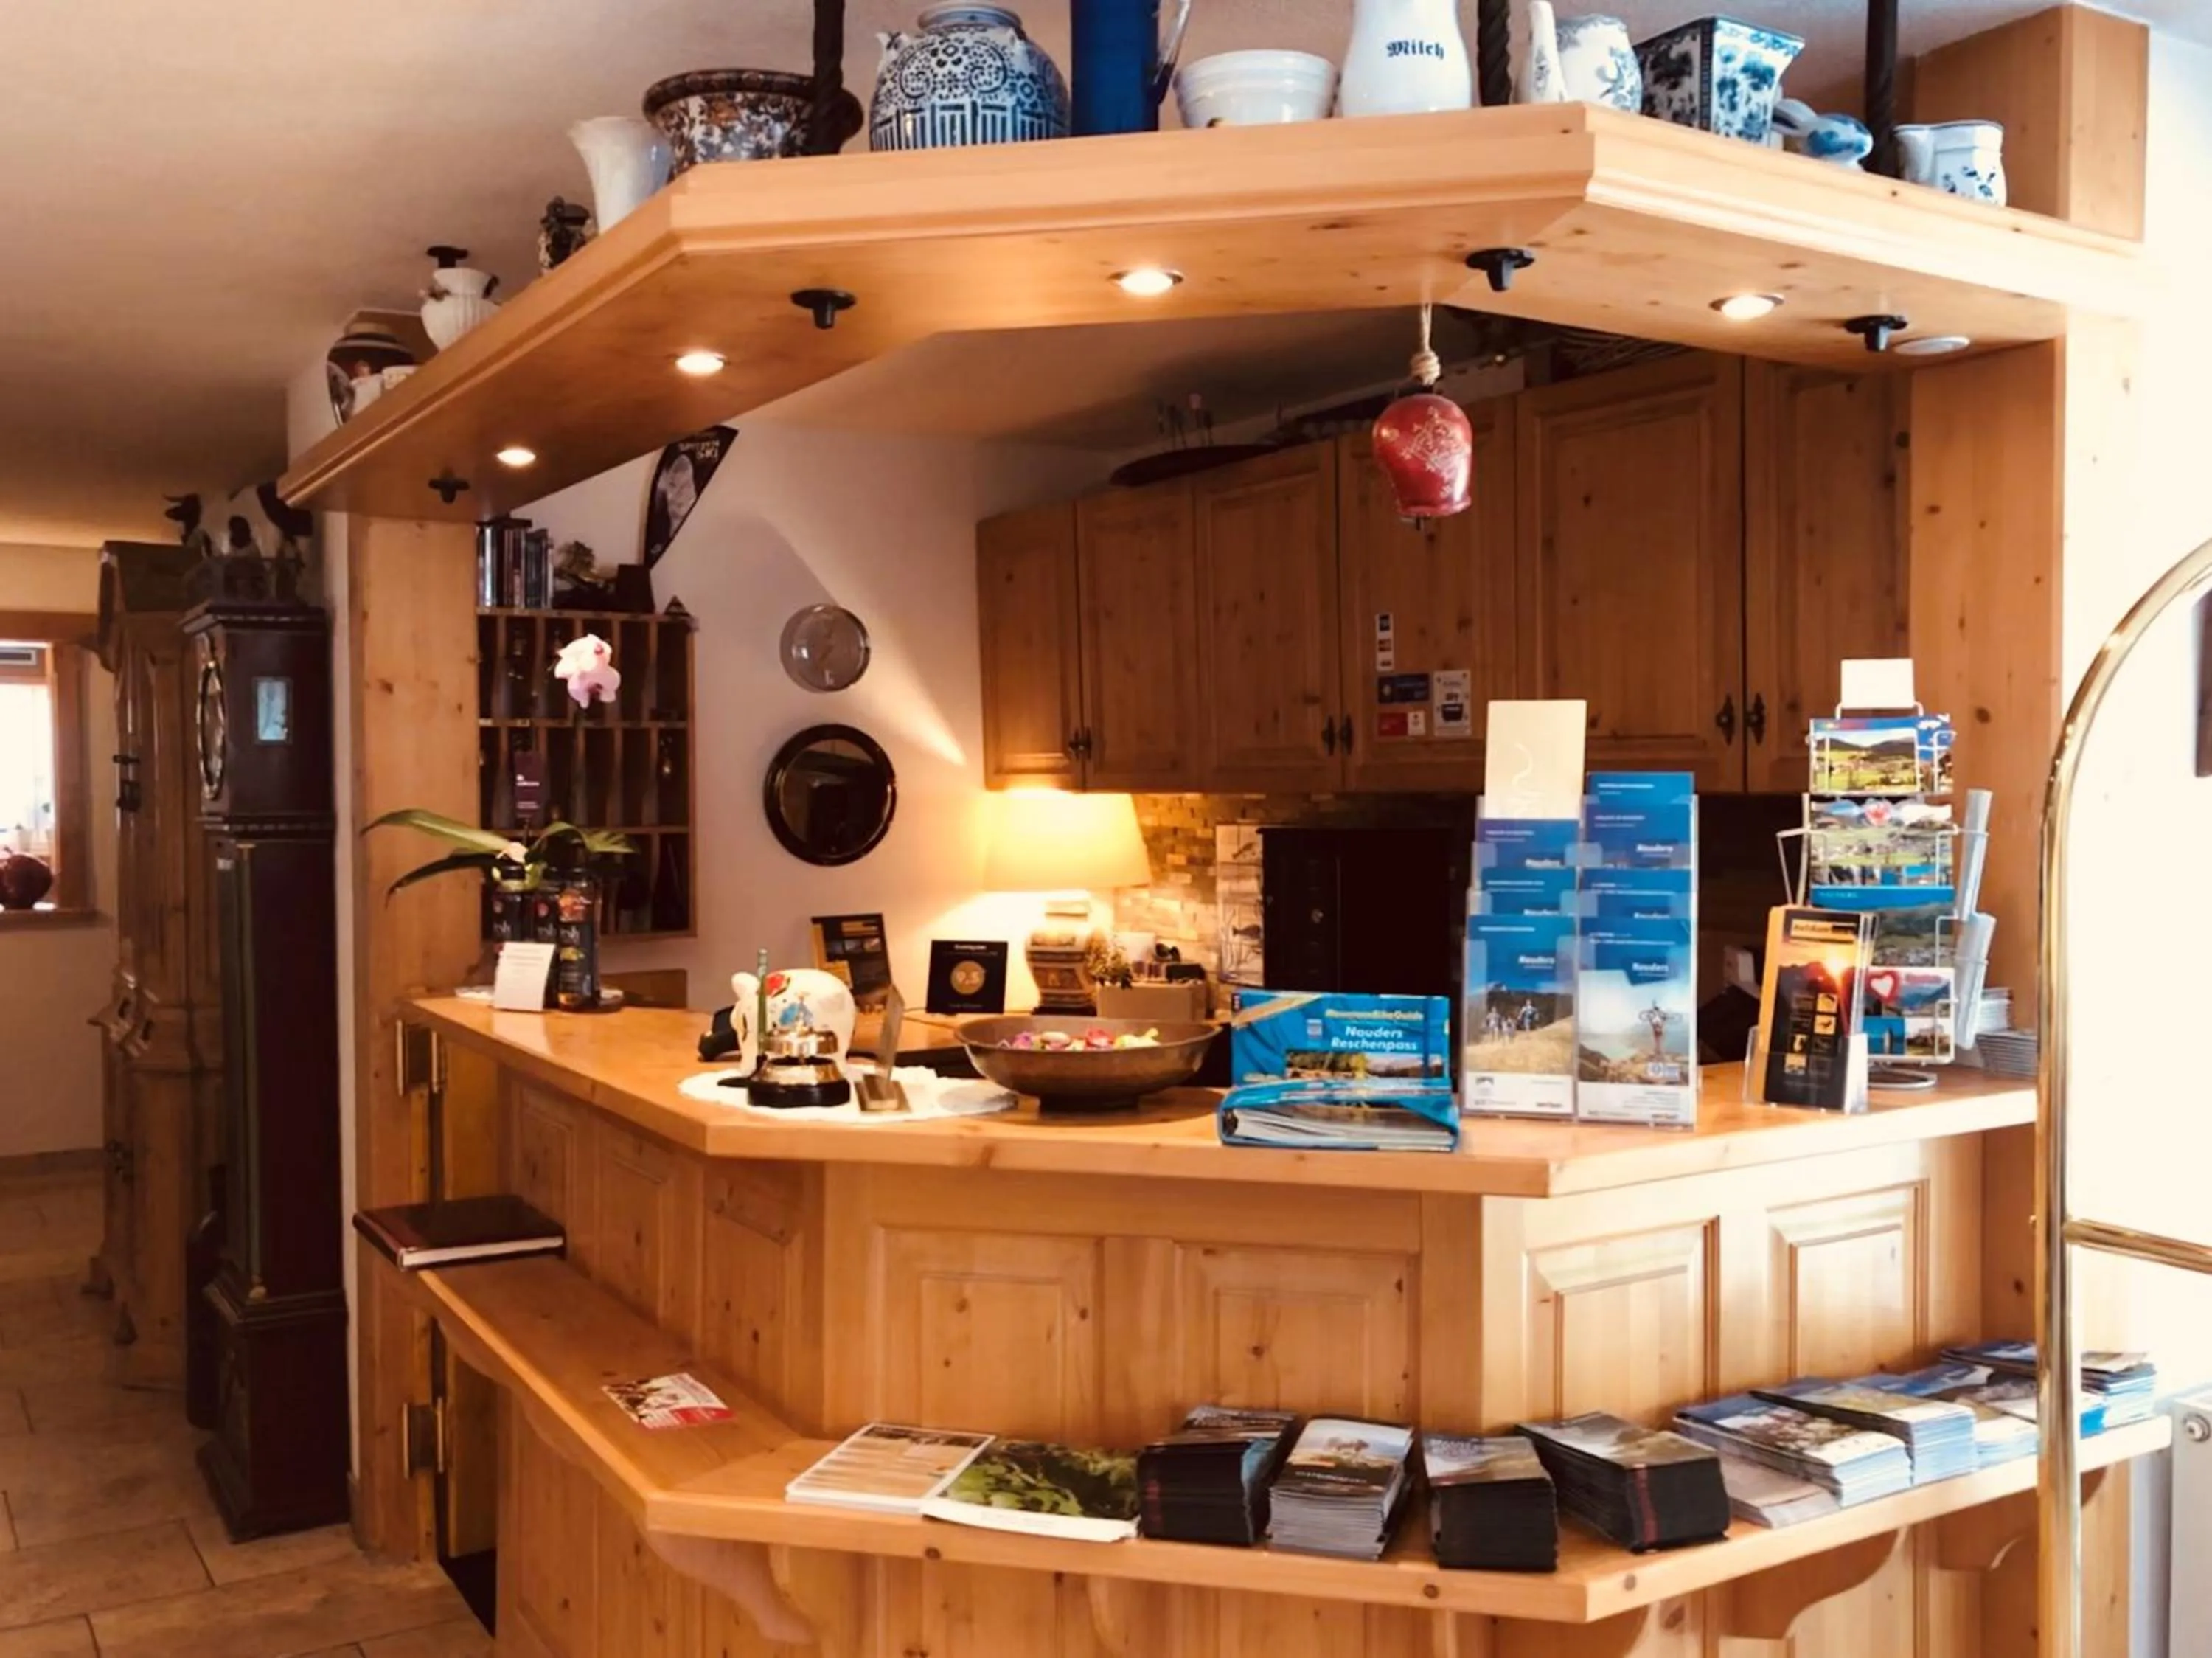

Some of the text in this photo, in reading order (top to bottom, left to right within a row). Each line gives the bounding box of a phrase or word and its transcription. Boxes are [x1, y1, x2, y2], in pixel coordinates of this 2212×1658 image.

[1387, 39, 1444, 60] Milch
[1345, 1026, 1403, 1038] Nauders
[1331, 1036, 1417, 1051] Reschenpass
